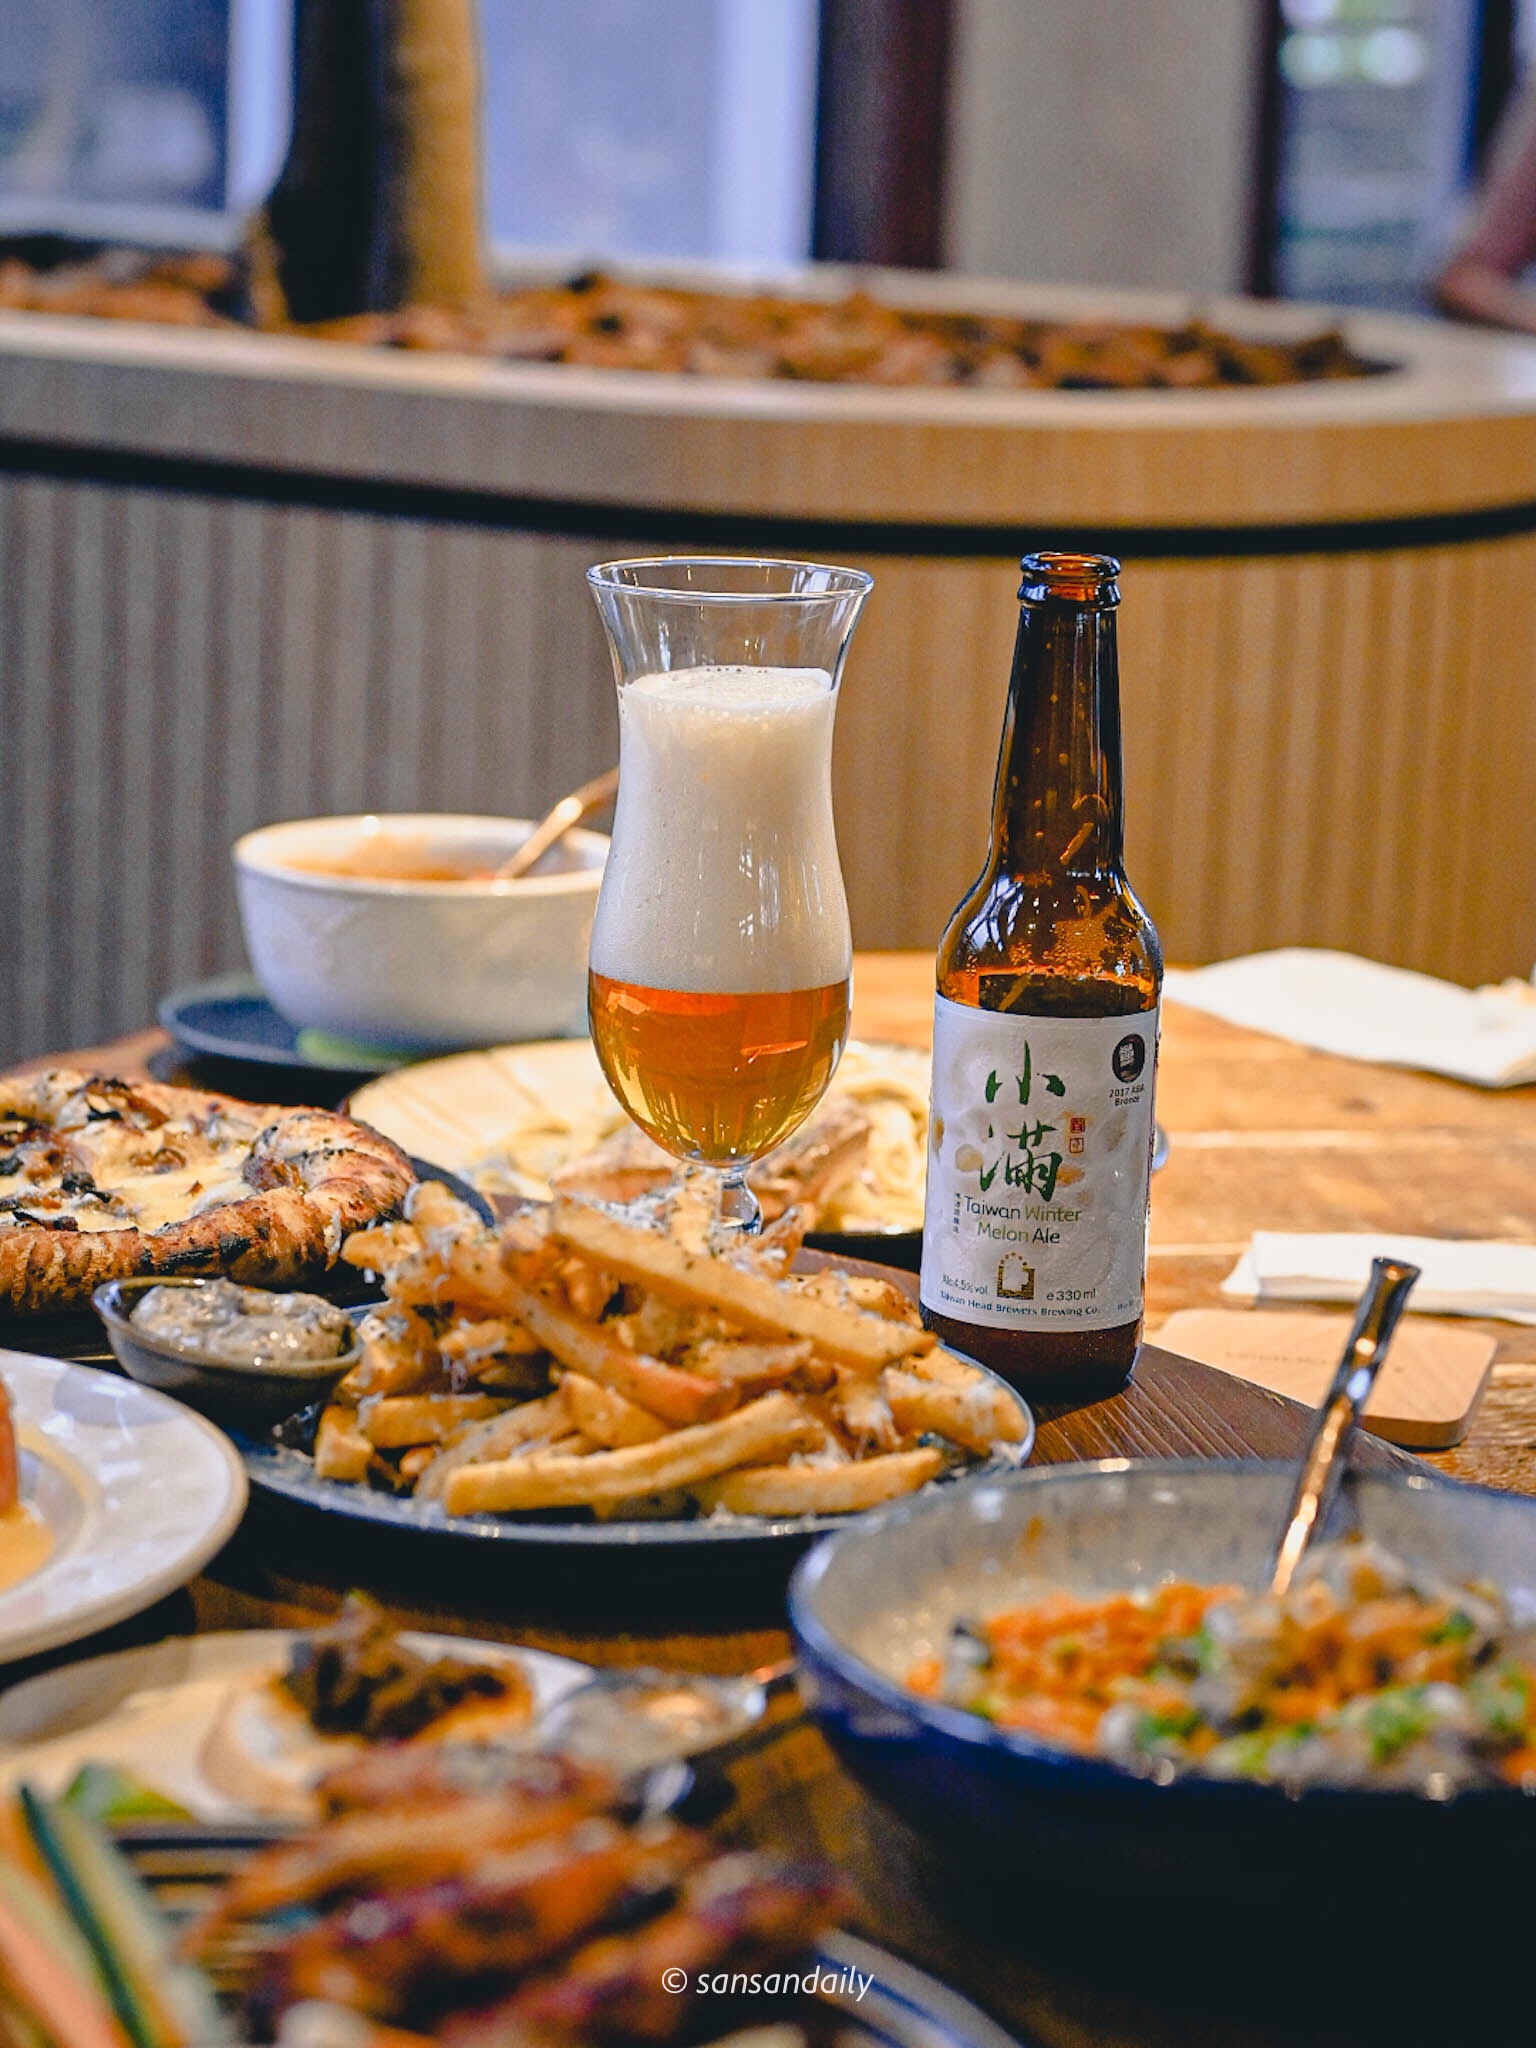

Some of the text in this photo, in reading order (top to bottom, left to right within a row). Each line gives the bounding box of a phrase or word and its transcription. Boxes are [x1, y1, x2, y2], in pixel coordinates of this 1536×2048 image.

[1109, 1088, 1130, 1098] 2017
[964, 1196, 1021, 1220] Taiwan
[1025, 1205, 1082, 1222] Winter
[977, 1221, 1061, 1244] Melon Ale
[968, 1299, 992, 1311] Head
[996, 1303, 1037, 1315] Brewers
[1041, 1307, 1082, 1317] Brewing
